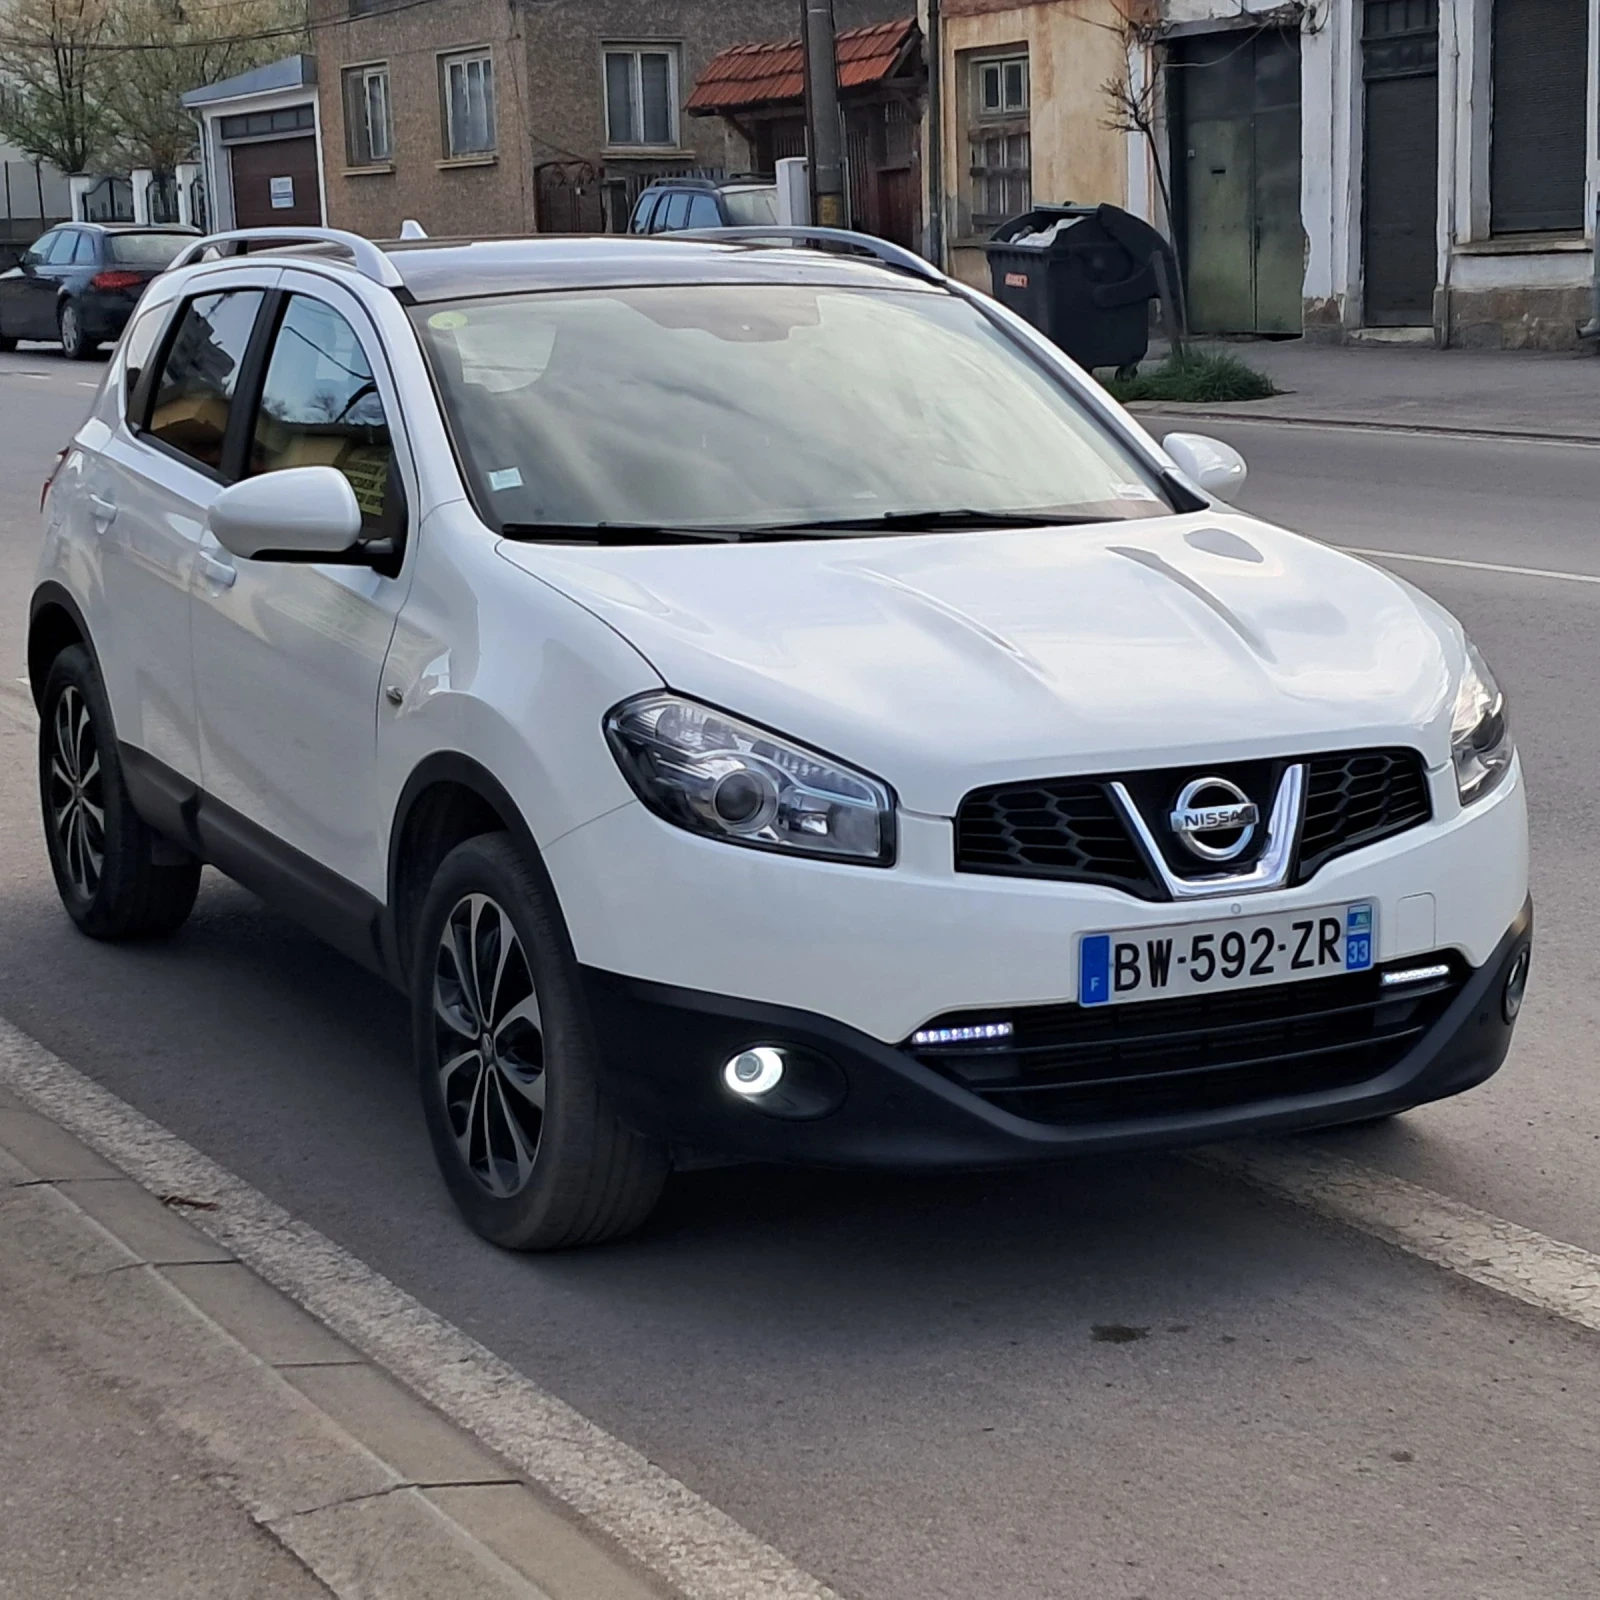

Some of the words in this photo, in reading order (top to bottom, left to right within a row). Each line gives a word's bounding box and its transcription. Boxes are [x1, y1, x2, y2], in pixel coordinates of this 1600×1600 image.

[1184, 809, 1253, 828] NISSA
[1114, 917, 1341, 992] BW-592-ZR
[1348, 940, 1369, 964] 33
[1090, 976, 1100, 992] F
